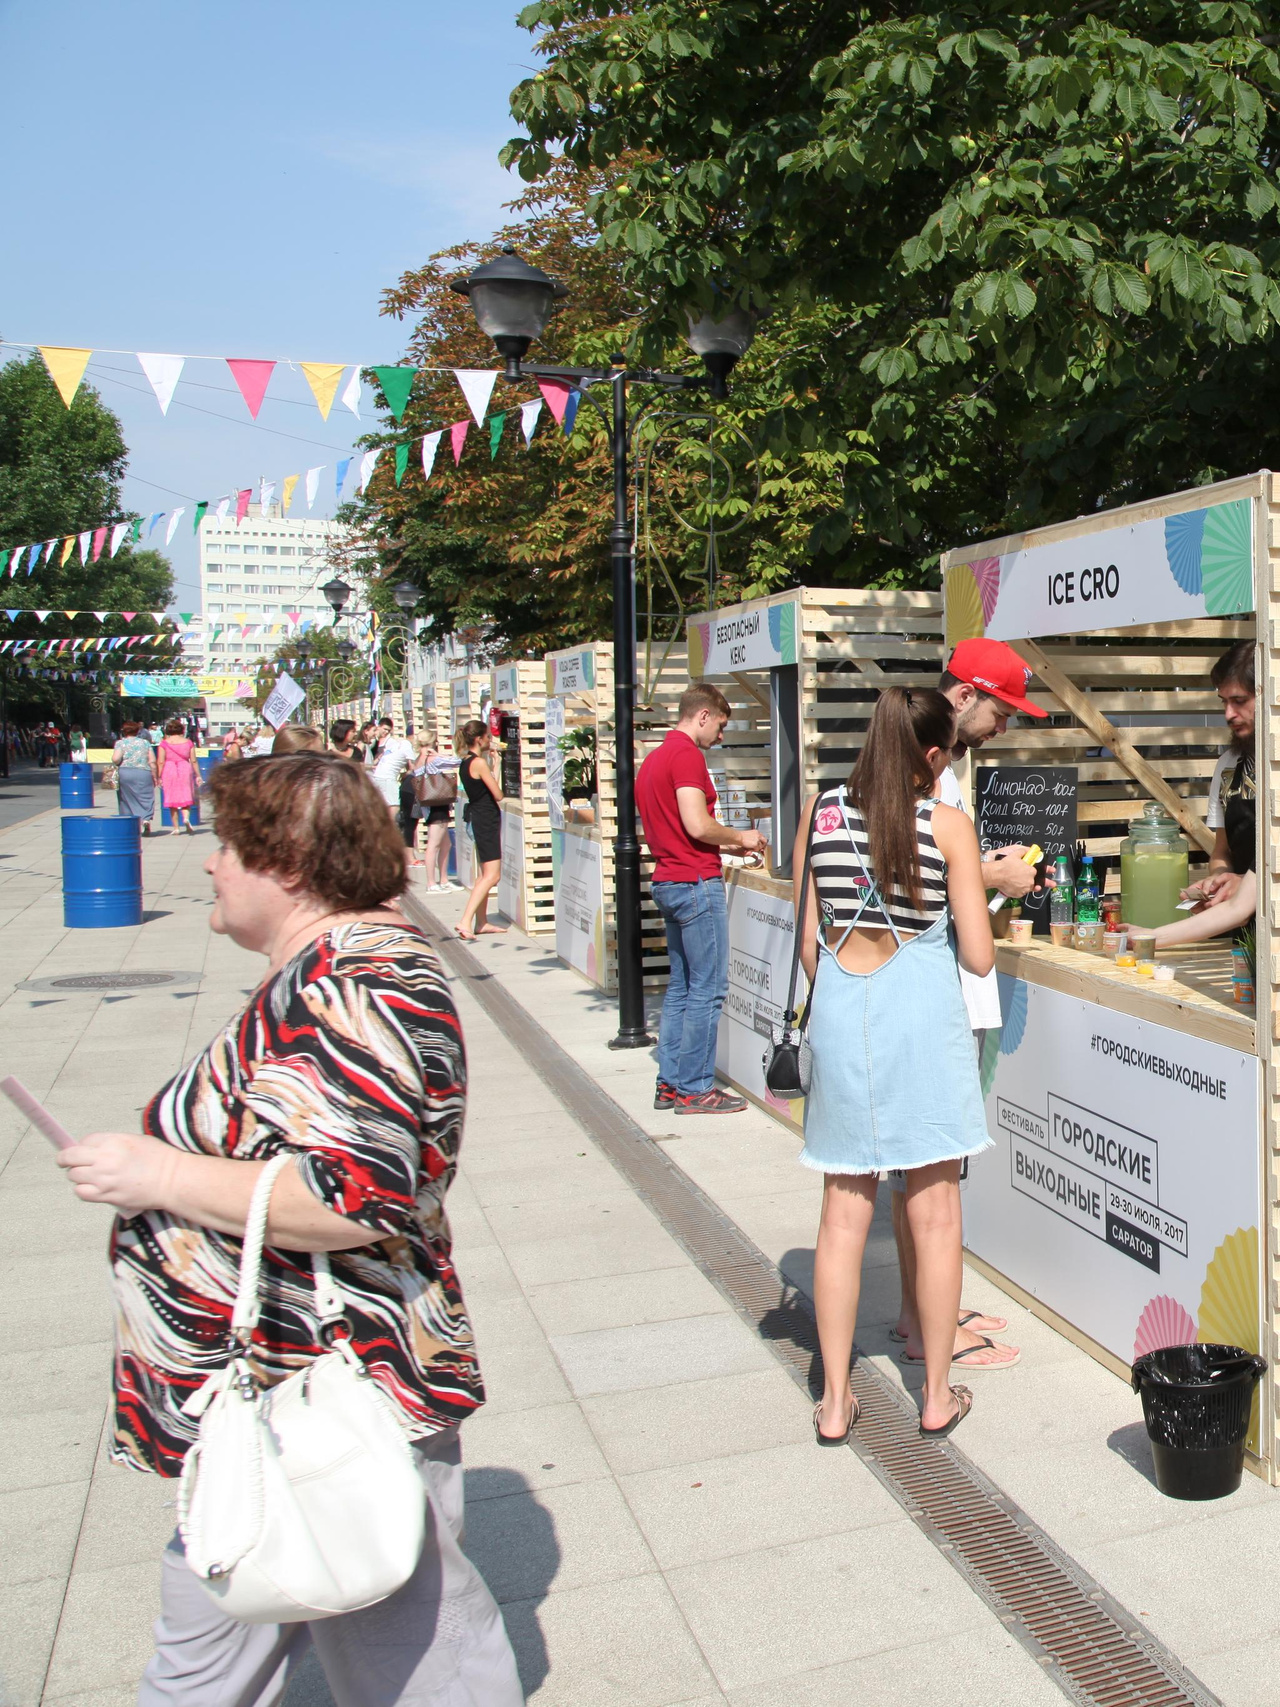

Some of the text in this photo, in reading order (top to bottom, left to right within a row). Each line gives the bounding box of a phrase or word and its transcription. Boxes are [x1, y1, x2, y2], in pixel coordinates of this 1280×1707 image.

[1048, 564, 1120, 606] ICE CRO
[716, 611, 760, 645] БЕЗОПАСНЫЙ
[730, 644, 746, 666] КЕКС
[980, 820, 1034, 836] Газировка
[733, 959, 770, 991] ГОРОДСКИЕ
[1090, 1033, 1227, 1101] #ГОРОДСКИЕВЫХОДНЫЕ
[1001, 1107, 1045, 1139] ФЕСТИВАЛЬ
[1053, 1112, 1152, 1185] ГОРОДСКИЕ
[1015, 1150, 1101, 1220] ВЫХОДНЫЕ
[1110, 1192, 1184, 1243] 29-30 ИЮЛЯ, 2017
[1112, 1223, 1154, 1260] САРАТОВ
